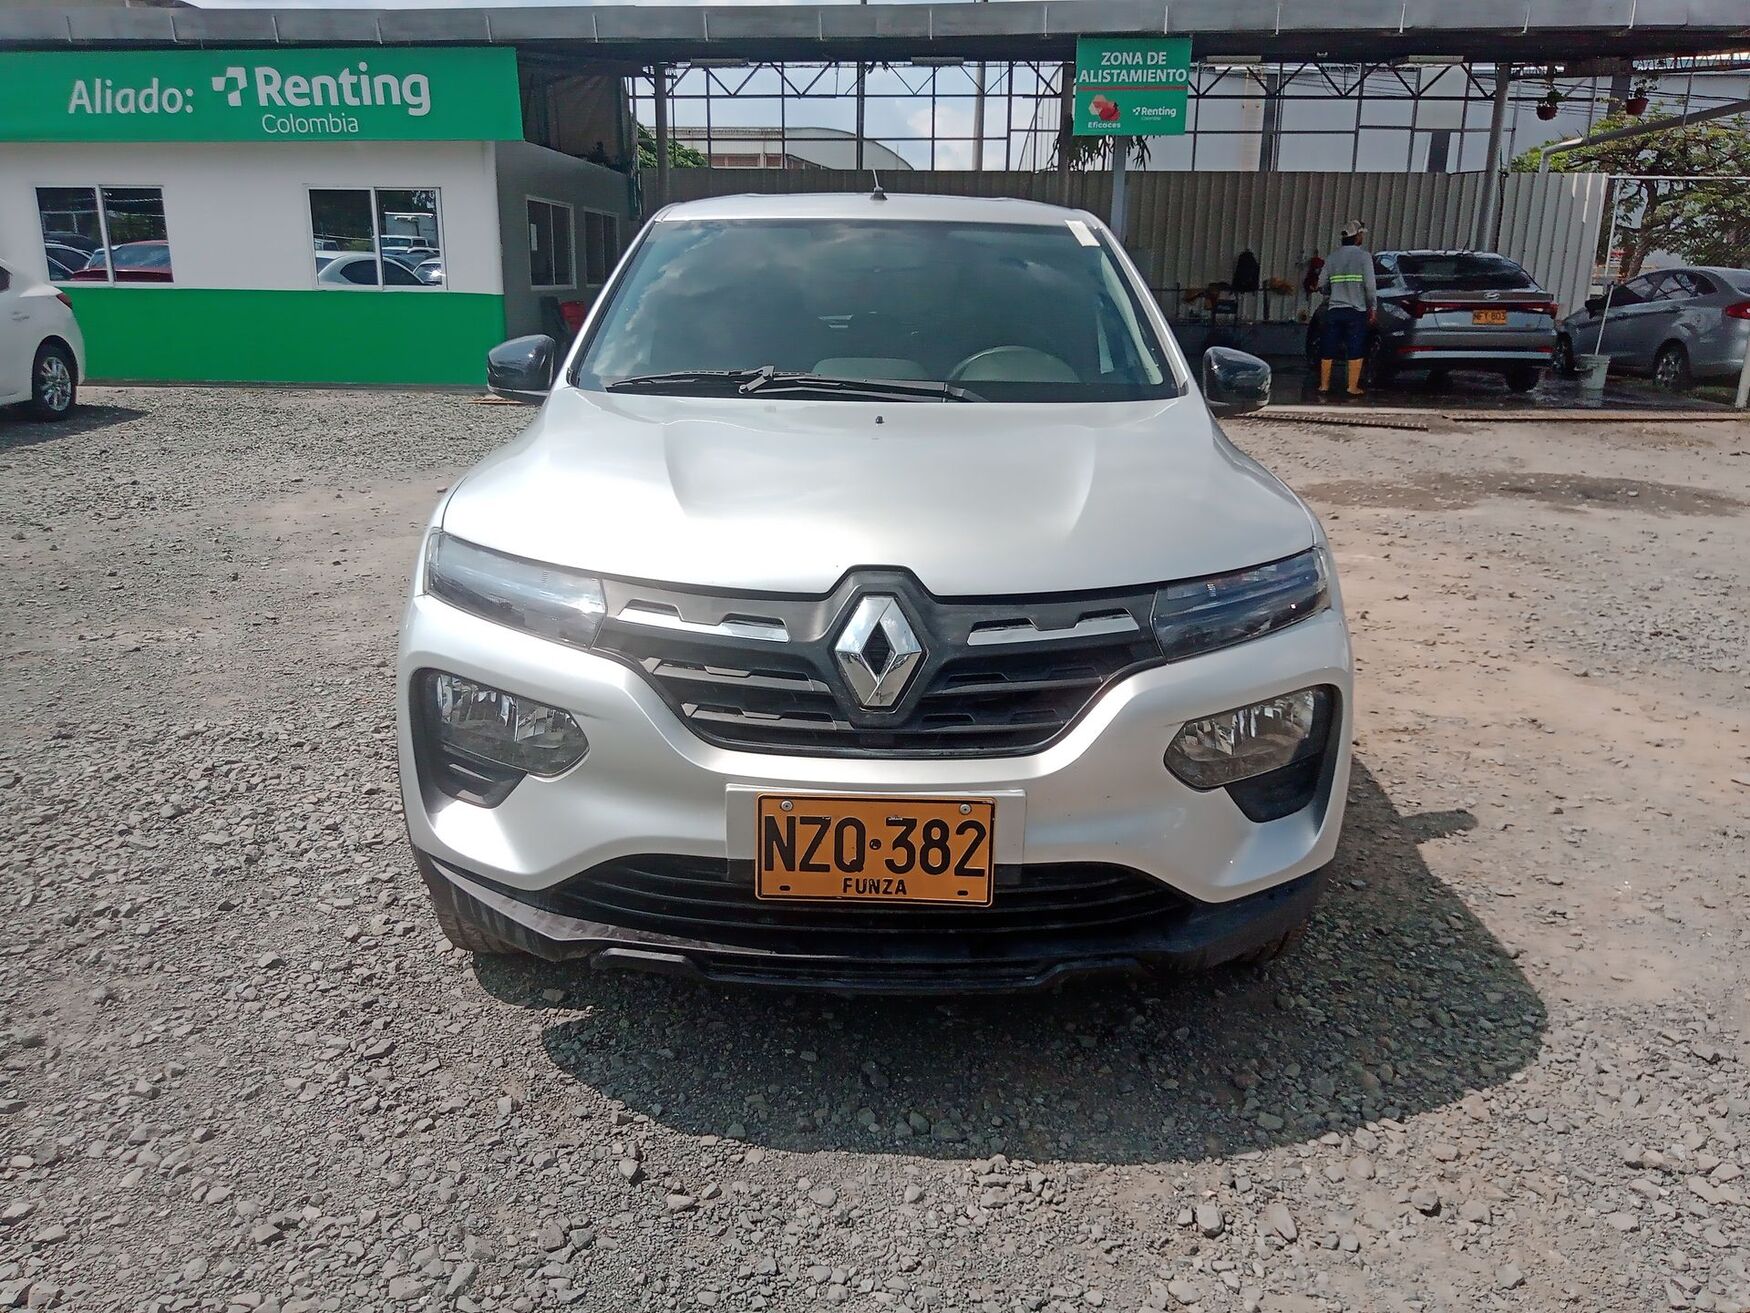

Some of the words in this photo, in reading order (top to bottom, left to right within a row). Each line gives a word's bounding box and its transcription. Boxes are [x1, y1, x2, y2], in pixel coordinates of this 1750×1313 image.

[1101, 51, 1143, 65] ZONA
[1147, 51, 1167, 65] DE
[1079, 68, 1187, 83] ALISTAMIENTO
[67, 77, 194, 114] Aliado:
[254, 61, 431, 116] Renting
[1141, 106, 1177, 117] Renting
[262, 113, 359, 134] Colombia
[842, 877, 907, 896] FUNZA
